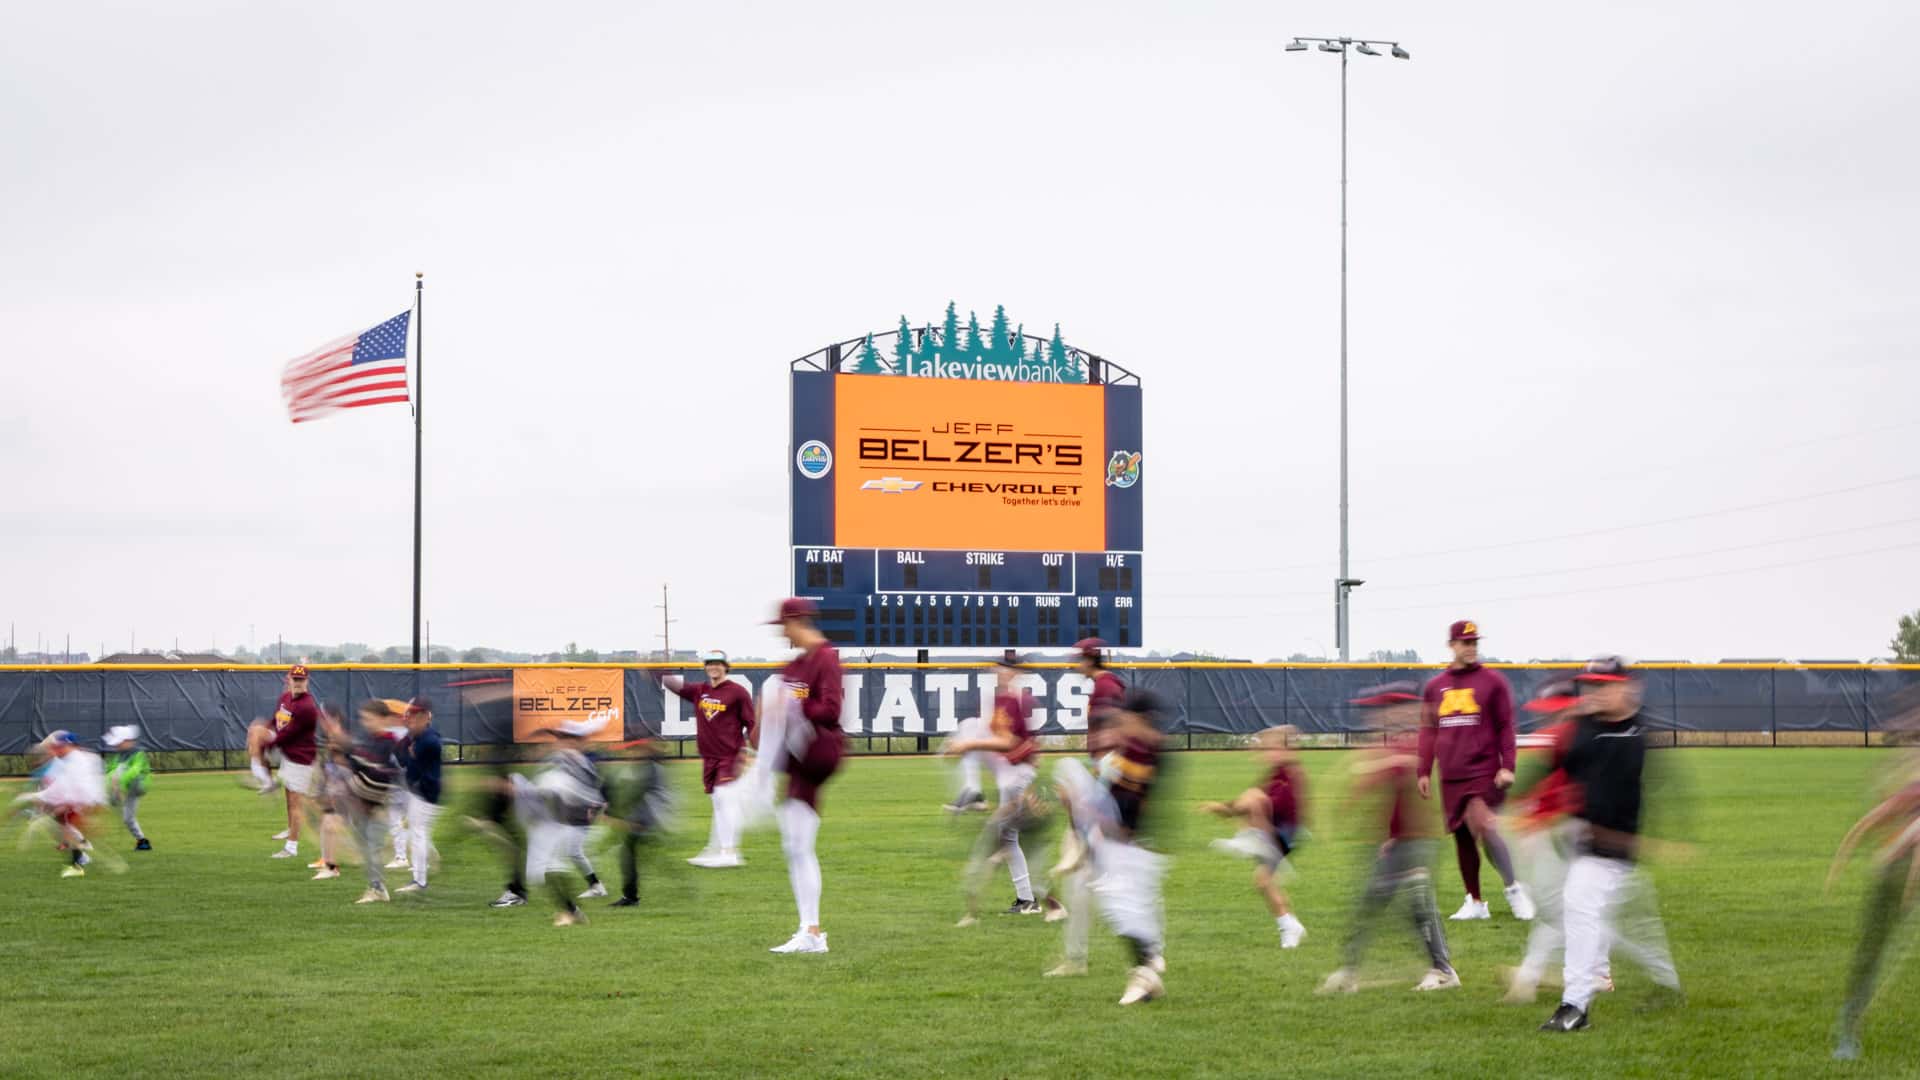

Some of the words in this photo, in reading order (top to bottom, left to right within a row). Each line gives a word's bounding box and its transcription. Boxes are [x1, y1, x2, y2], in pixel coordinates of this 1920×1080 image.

[932, 422, 1014, 436] JEFF
[859, 438, 1082, 466] BELZER'S
[932, 482, 1083, 495] CHEVROLET
[1002, 496, 1040, 507] Together
[1060, 497, 1081, 507] drive
[806, 550, 820, 563] AT
[823, 550, 845, 563] BAT
[897, 551, 926, 564] BALL
[966, 552, 1005, 565] STRIKE
[1042, 553, 1065, 566] OUT
[1106, 554, 1125, 568] H/E
[866, 594, 872, 606] 1
[881, 594, 888, 606] 2
[897, 595, 904, 606] 3
[915, 595, 921, 606] 4
[930, 595, 936, 606] 5
[945, 595, 952, 606] 6
[963, 595, 969, 607] 7
[978, 595, 984, 607] 8
[993, 595, 999, 607] 9
[1007, 596, 1019, 607] 10
[1035, 596, 1060, 608] RUNS
[1078, 596, 1098, 608] HITS
[1115, 597, 1133, 608] ERR
[545, 686, 587, 694] JEFF
[519, 697, 612, 711] BELZER
